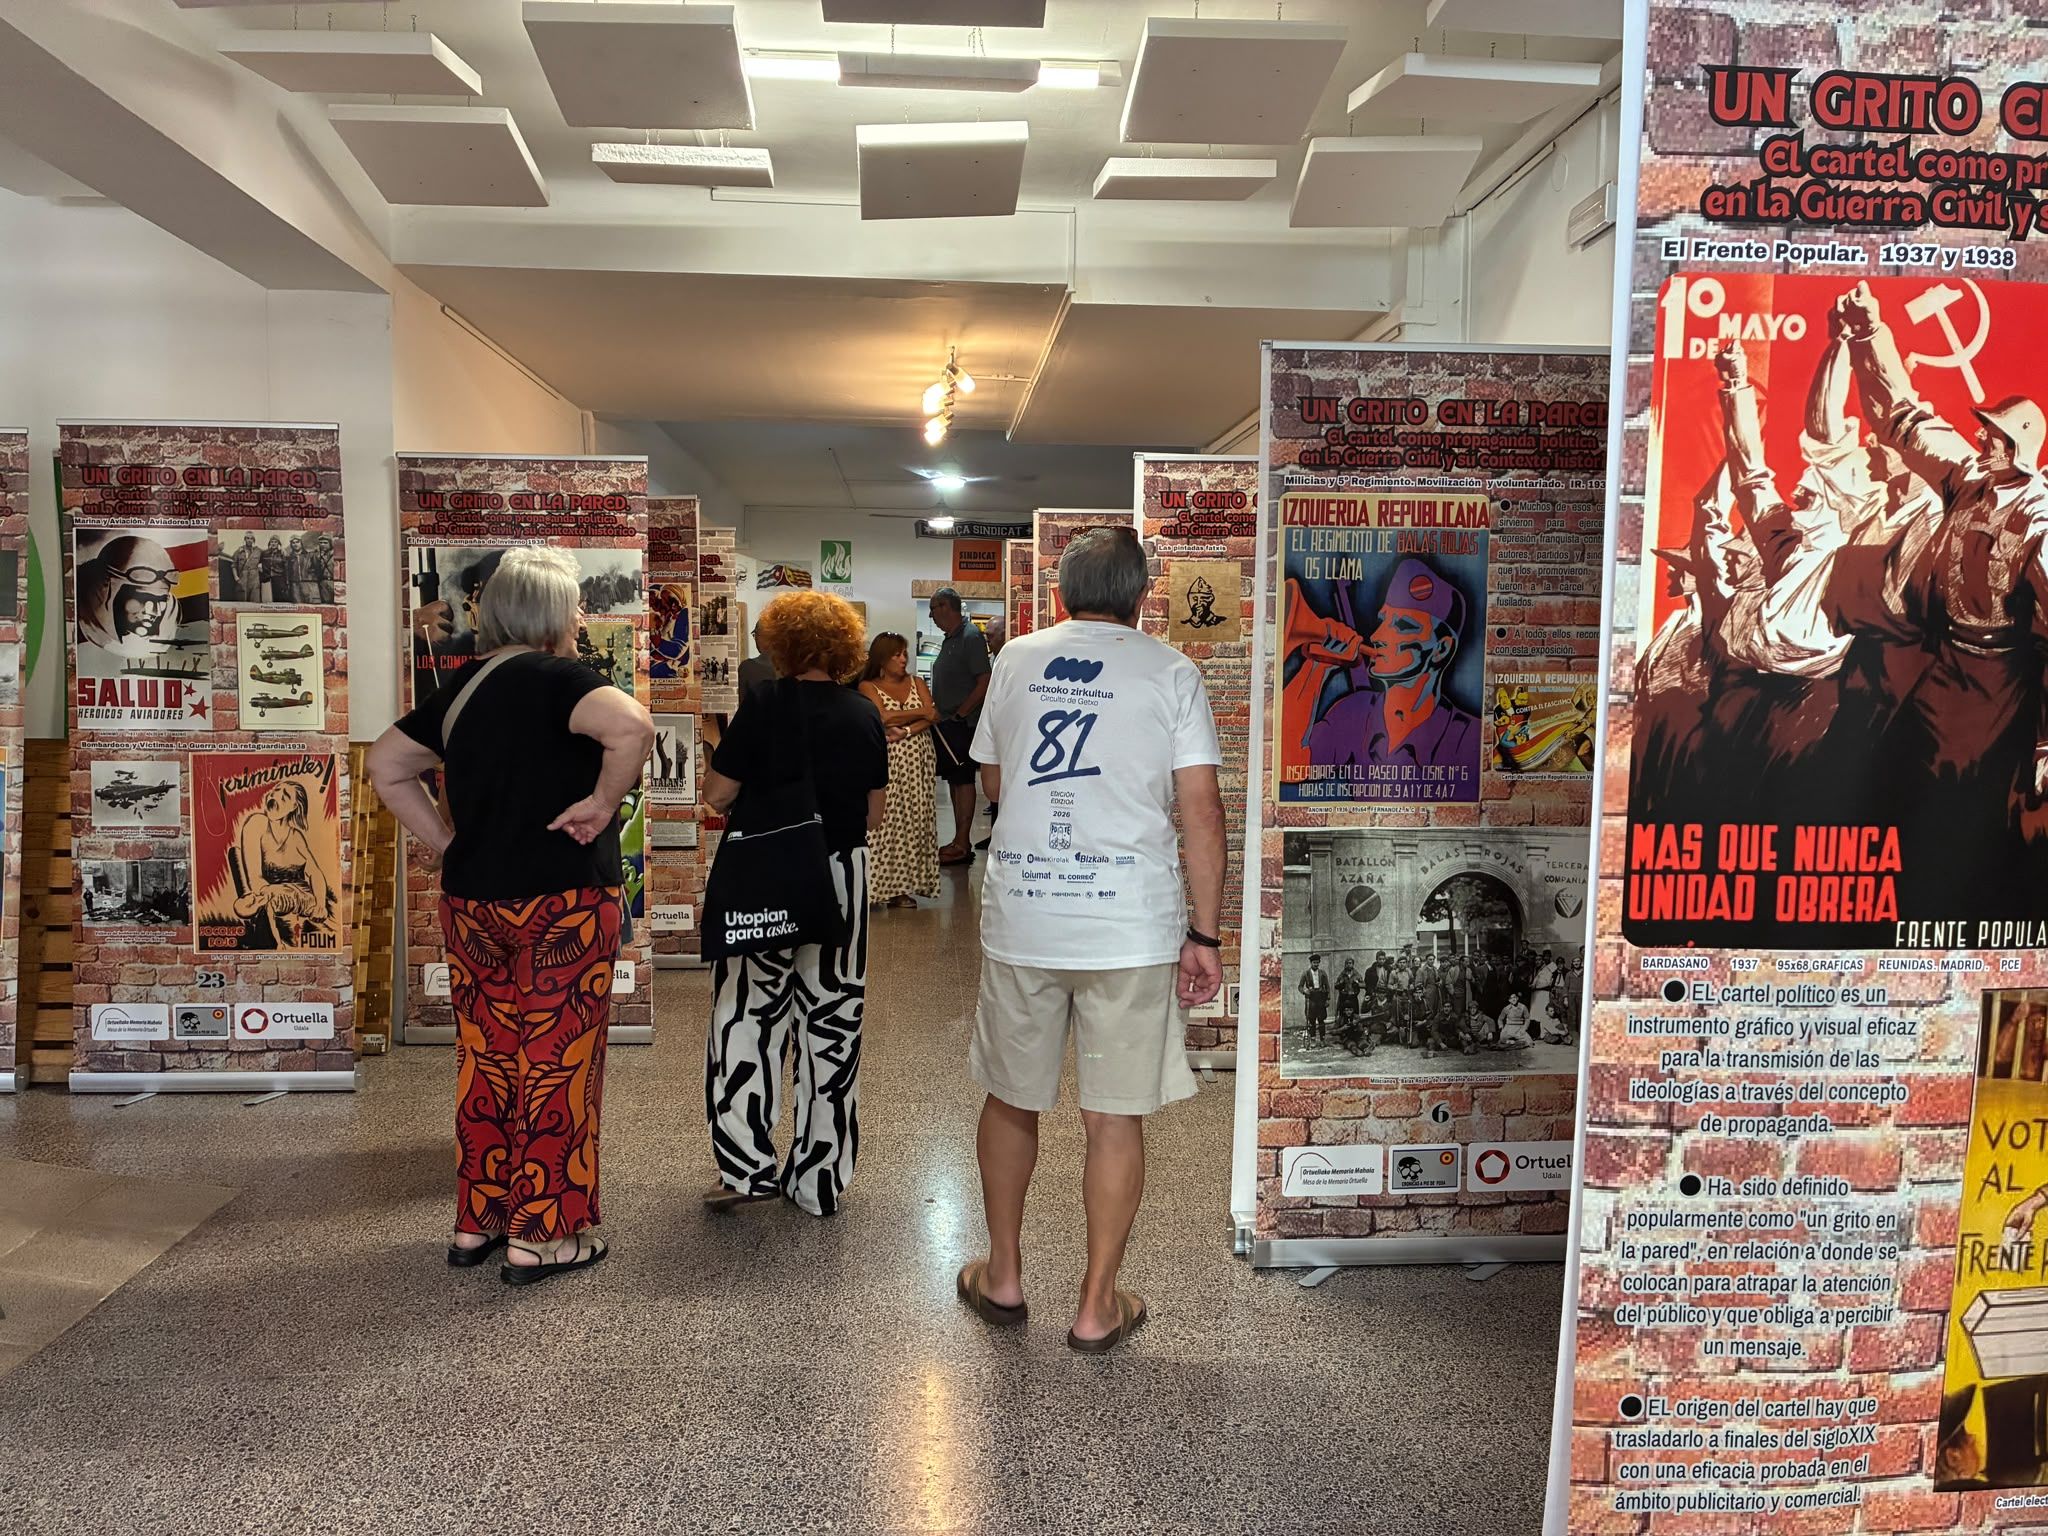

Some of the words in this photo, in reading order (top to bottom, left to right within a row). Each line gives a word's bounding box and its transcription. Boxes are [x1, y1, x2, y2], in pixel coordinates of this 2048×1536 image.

[1709, 68, 1793, 125] UN
[1812, 73, 1981, 132] GRITO
[1764, 137, 1802, 174] El
[1810, 140, 1909, 178] cartel
[1918, 153, 2008, 181] como
[1705, 193, 1745, 217] en
[1756, 185, 1791, 218] la
[1801, 185, 1922, 222] Guerra
[1932, 189, 2006, 227] Civil
[2010, 202, 2033, 240] y
[1664, 240, 1685, 257] El
[1694, 242, 1767, 259] Frente
[1776, 244, 1866, 264] Popular.
[1884, 246, 1938, 262] 1937
[1942, 251, 1958, 268] y
[1965, 249, 2014, 266] 1938
[1718, 314, 1807, 340] MAYO
[1689, 337, 1718, 359] DE
[1301, 399, 1339, 422] UN
[1348, 399, 1428, 424] GRITO
[1438, 401, 1474, 425] EN
[1485, 401, 1518, 425] LA
[83, 468, 110, 484] UN
[117, 468, 176, 485] GRITO
[184, 468, 210, 485] EN
[220, 470, 243, 485] LA
[252, 470, 321, 488] PARED.
[1285, 476, 1325, 485] Milicias
[1328, 478, 1334, 486] y
[1352, 477, 1414, 487] Regimiento.
[1418, 478, 1481, 487] Movilización
[1497, 480, 1564, 488] voluntariado.
[1571, 480, 1585, 488] IR.
[418, 495, 443, 508] UN
[450, 495, 503, 509] GRITO
[509, 495, 533, 509] EN
[542, 495, 563, 509] LA
[571, 496, 630, 511] PARED.
[1161, 493, 1186, 507] UN
[1193, 493, 1245, 508] GRITO
[1283, 499, 1369, 527] IZQUIERDA
[1378, 500, 1490, 528] REPUBLICANA
[973, 526, 1021, 536] SINDICAT
[1292, 530, 1307, 551] EL
[1311, 530, 1372, 553] REGIMIENTO
[1377, 531, 1393, 553] DE
[1397, 531, 1437, 554] BALAS
[1440, 531, 1478, 554] ROJAS
[1305, 557, 1320, 579] OS
[1325, 558, 1363, 580] LLAMA
[1512, 646, 1528, 654] esta
[1531, 646, 1575, 656] exposición.
[417, 656, 434, 669] LOS
[1495, 674, 1541, 684] IZQUIERDA
[78, 678, 183, 708] SALUD
[1029, 684, 1069, 695] Getxoko
[1071, 687, 1114, 699] zirkuitua
[1041, 695, 1065, 703] Circuito
[1078, 698, 1098, 706] Getxo
[78, 708, 122, 719] HEROICOS
[130, 709, 183, 719] AVIADORES
[1030, 709, 1098, 774] 81
[1002, 851, 1021, 860] Getxo
[1632, 824, 1703, 871] MAS
[1718, 825, 1778, 873] QUE
[1795, 826, 1902, 872] NUNCA
[1336, 856, 1395, 867] BATALLÓN
[1420, 848, 1460, 875] BALAS
[1485, 849, 1524, 874] ROJAS
[1629, 875, 1755, 921] UNIDAD
[1776, 876, 1898, 922] OBRERA
[651, 912, 689, 920] Ortuella
[725, 908, 788, 928] Utopian
[200, 926, 245, 936] SOCORRO
[301, 934, 336, 948] POUM
[725, 927, 763, 944] gara
[767, 921, 798, 939] aske.
[1896, 920, 1968, 948] FRENTE
[208, 938, 237, 947] ROJO
[1642, 958, 1708, 969] BARDASANO
[1732, 959, 1758, 970] 1937
[1778, 959, 1809, 971] 95x68
[1812, 960, 1863, 970] GRAFICAS
[2001, 960, 2019, 970] PCE
[198, 973, 224, 988] 23
[1692, 984, 1715, 1001] EL
[1721, 985, 1770, 1002] cartel
[1776, 986, 1835, 1006] político
[1842, 990, 1860, 1002] es
[1867, 990, 1886, 1002] un
[272, 1013, 328, 1023] Ortuella
[1629, 1016, 1730, 1035] instrumento
[1735, 1017, 1794, 1040] gráfico
[1800, 1023, 1809, 1039] y
[1814, 1017, 1861, 1035] visual
[1867, 1018, 1916, 1035] eficaz
[1662, 1052, 1699, 1071] para
[1706, 1050, 1720, 1067] la
[1726, 1050, 1823, 1067] transmisión
[1830, 1050, 1849, 1067] de
[1856, 1050, 1879, 1067] las
[1632, 1082, 1719, 1104] ideologías
[1725, 1088, 1736, 1100] a
[1741, 1083, 1793, 1101] través
[1800, 1083, 1823, 1100] del
[1829, 1084, 1906, 1105] concepto
[1432, 1102, 1450, 1123] 6
[1701, 1115, 1721, 1133] de
[1727, 1115, 1832, 1137] propaganda.
[1516, 1155, 1573, 1169] Ortuel
[1708, 1178, 1732, 1196] Ha
[1743, 1178, 1777, 1196] sido
[1782, 1177, 1848, 1197] definido
[1978, 1163, 2023, 1201] AL
[1627, 1211, 1743, 1231] popularmente
[1748, 1213, 1793, 1229] como
[1800, 1212, 1828, 1229] "un
[1834, 1212, 1870, 1231] grito
[1876, 1213, 1895, 1229] en
[1622, 1242, 1636, 1259] la
[1642, 1243, 1702, 1263] pared",
[1708, 1246, 1728, 1260] en
[1734, 1242, 1800, 1261] relación
[1805, 1248, 1816, 1261] a
[1821, 1245, 1873, 1261] donde
[1879, 1247, 1897, 1261] se
[1958, 1232, 2034, 1284] FRENTE
